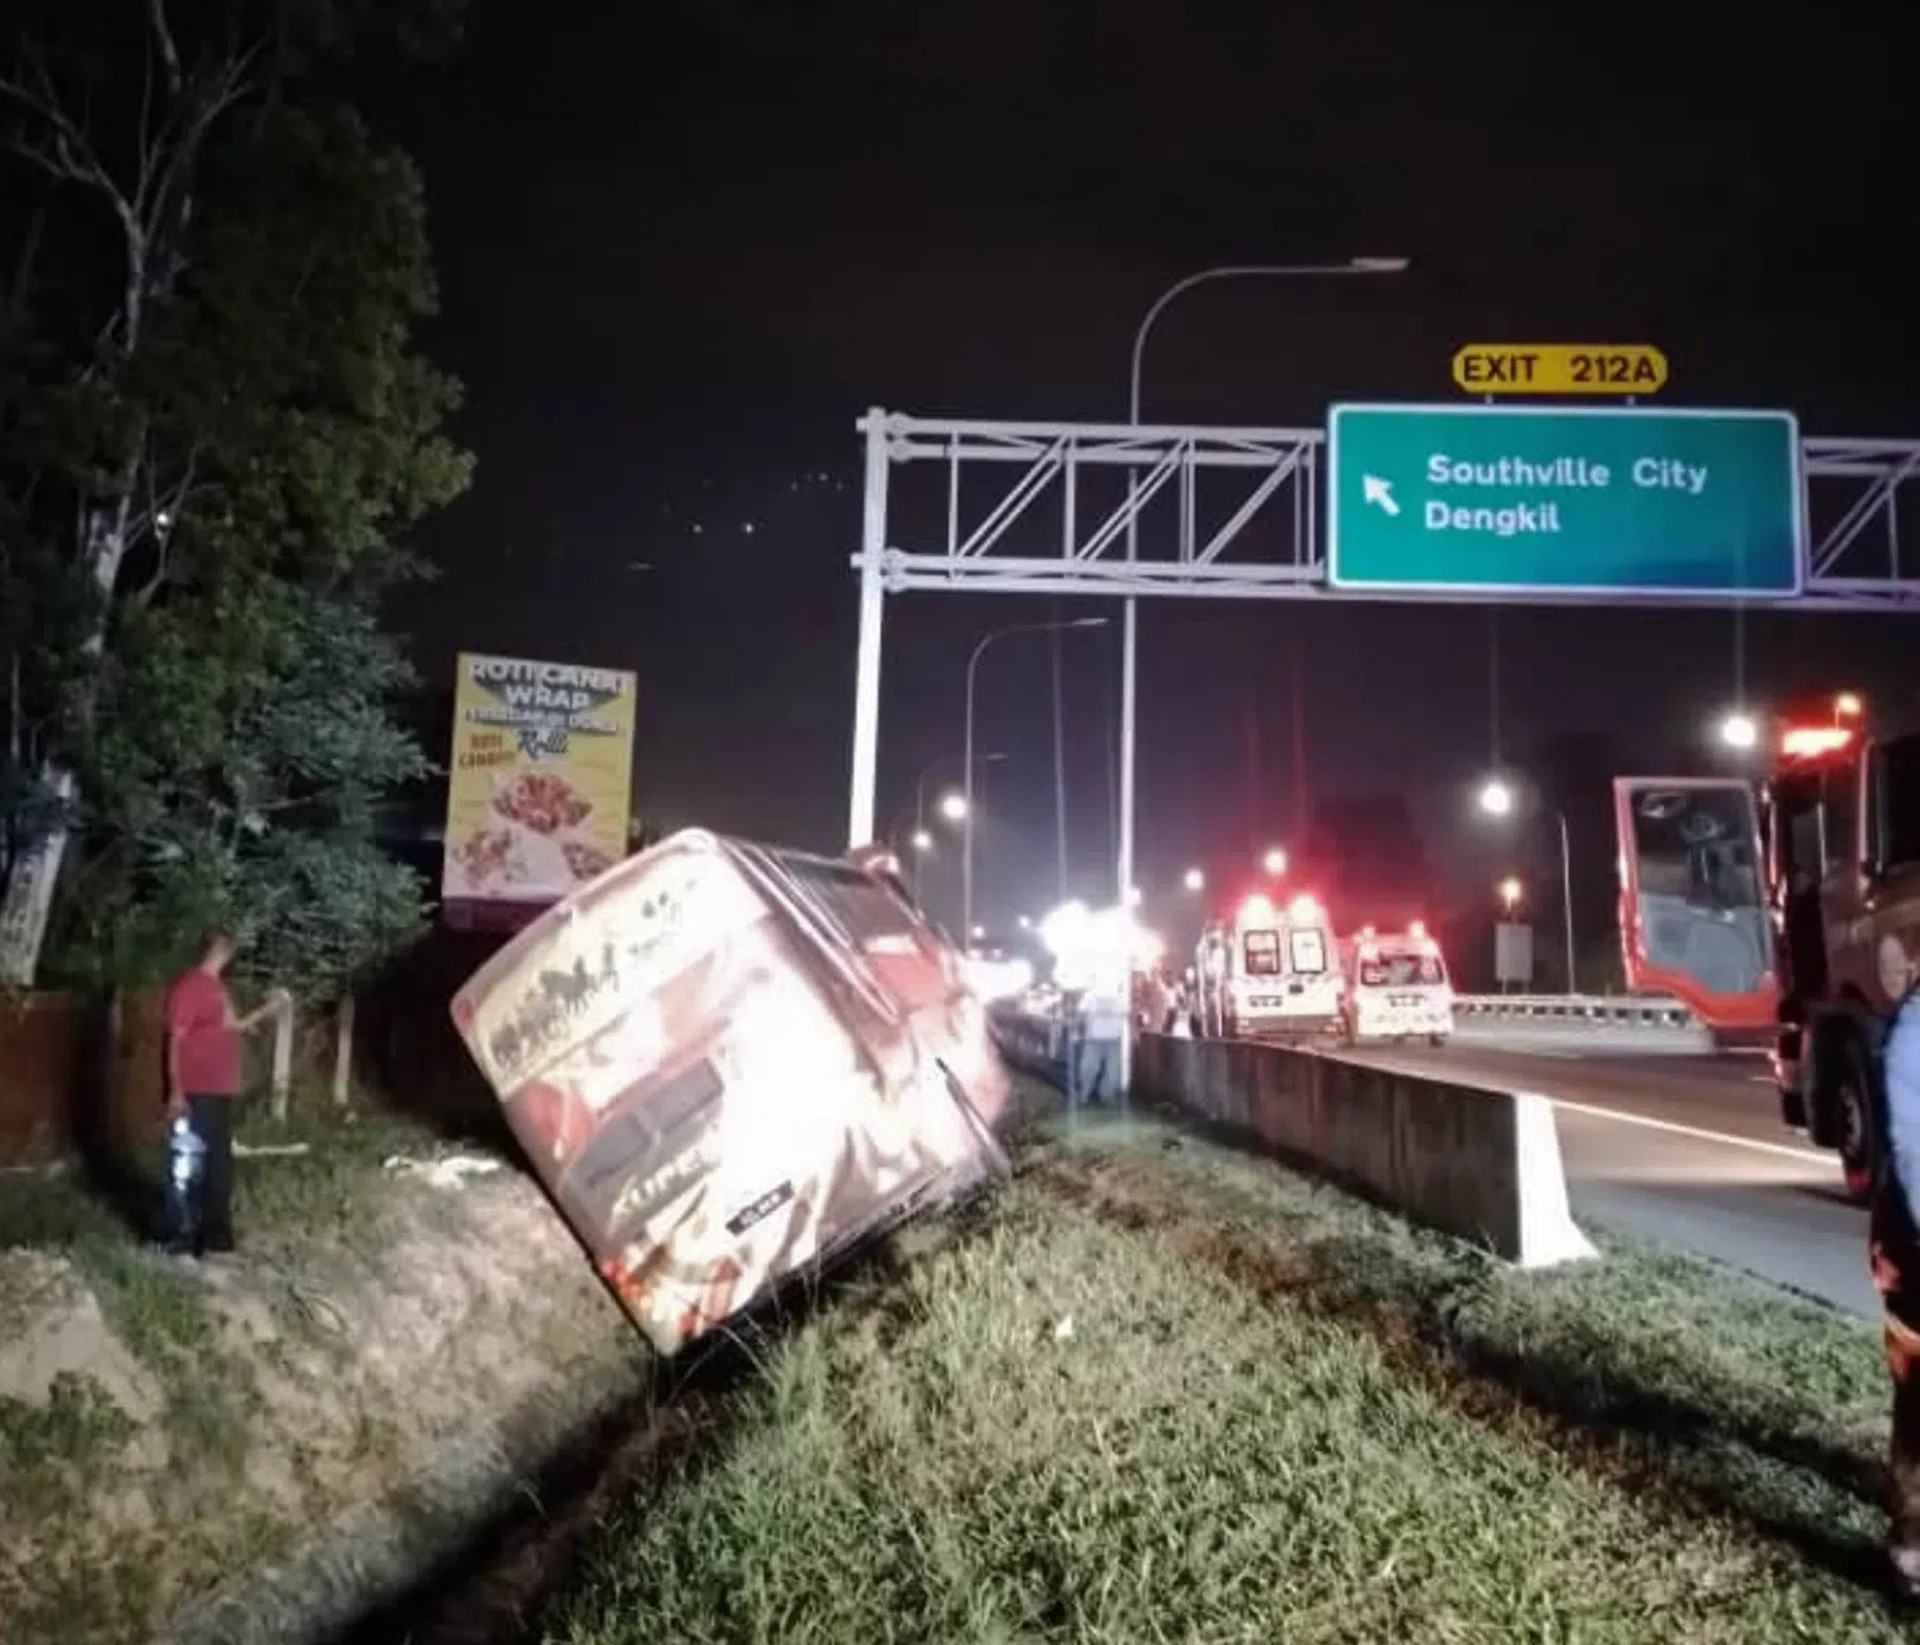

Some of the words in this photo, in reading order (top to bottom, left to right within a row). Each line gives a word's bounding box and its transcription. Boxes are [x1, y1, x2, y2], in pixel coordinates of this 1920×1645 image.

[1463, 354, 1539, 383] EXIT
[1570, 354, 1658, 384] 212A
[1427, 454, 1610, 487] Southville
[1632, 458, 1709, 494] City
[1425, 502, 1561, 537] Dengkil
[505, 685, 591, 709] WRAP
